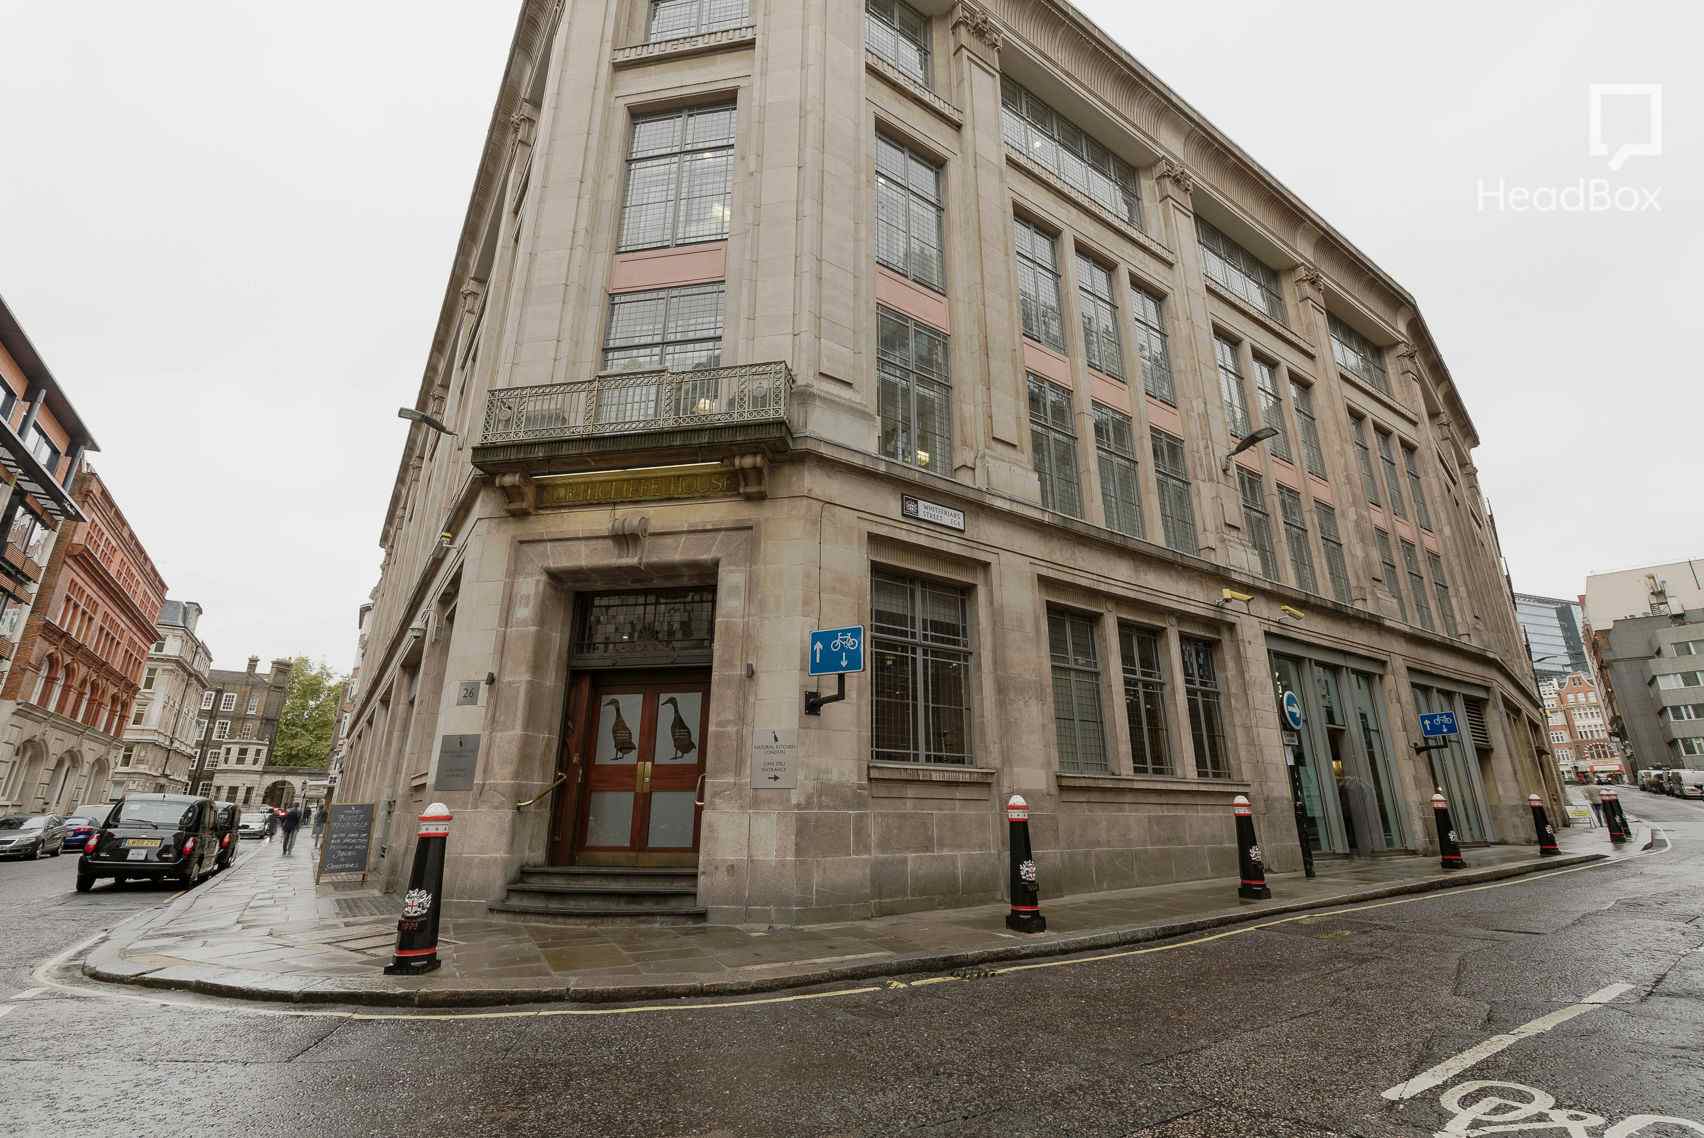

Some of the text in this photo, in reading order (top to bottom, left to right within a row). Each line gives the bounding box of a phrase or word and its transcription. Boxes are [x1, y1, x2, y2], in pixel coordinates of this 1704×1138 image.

[670, 473, 729, 496] HOUSE
[922, 510, 944, 520] STREET
[463, 687, 474, 698] 26
